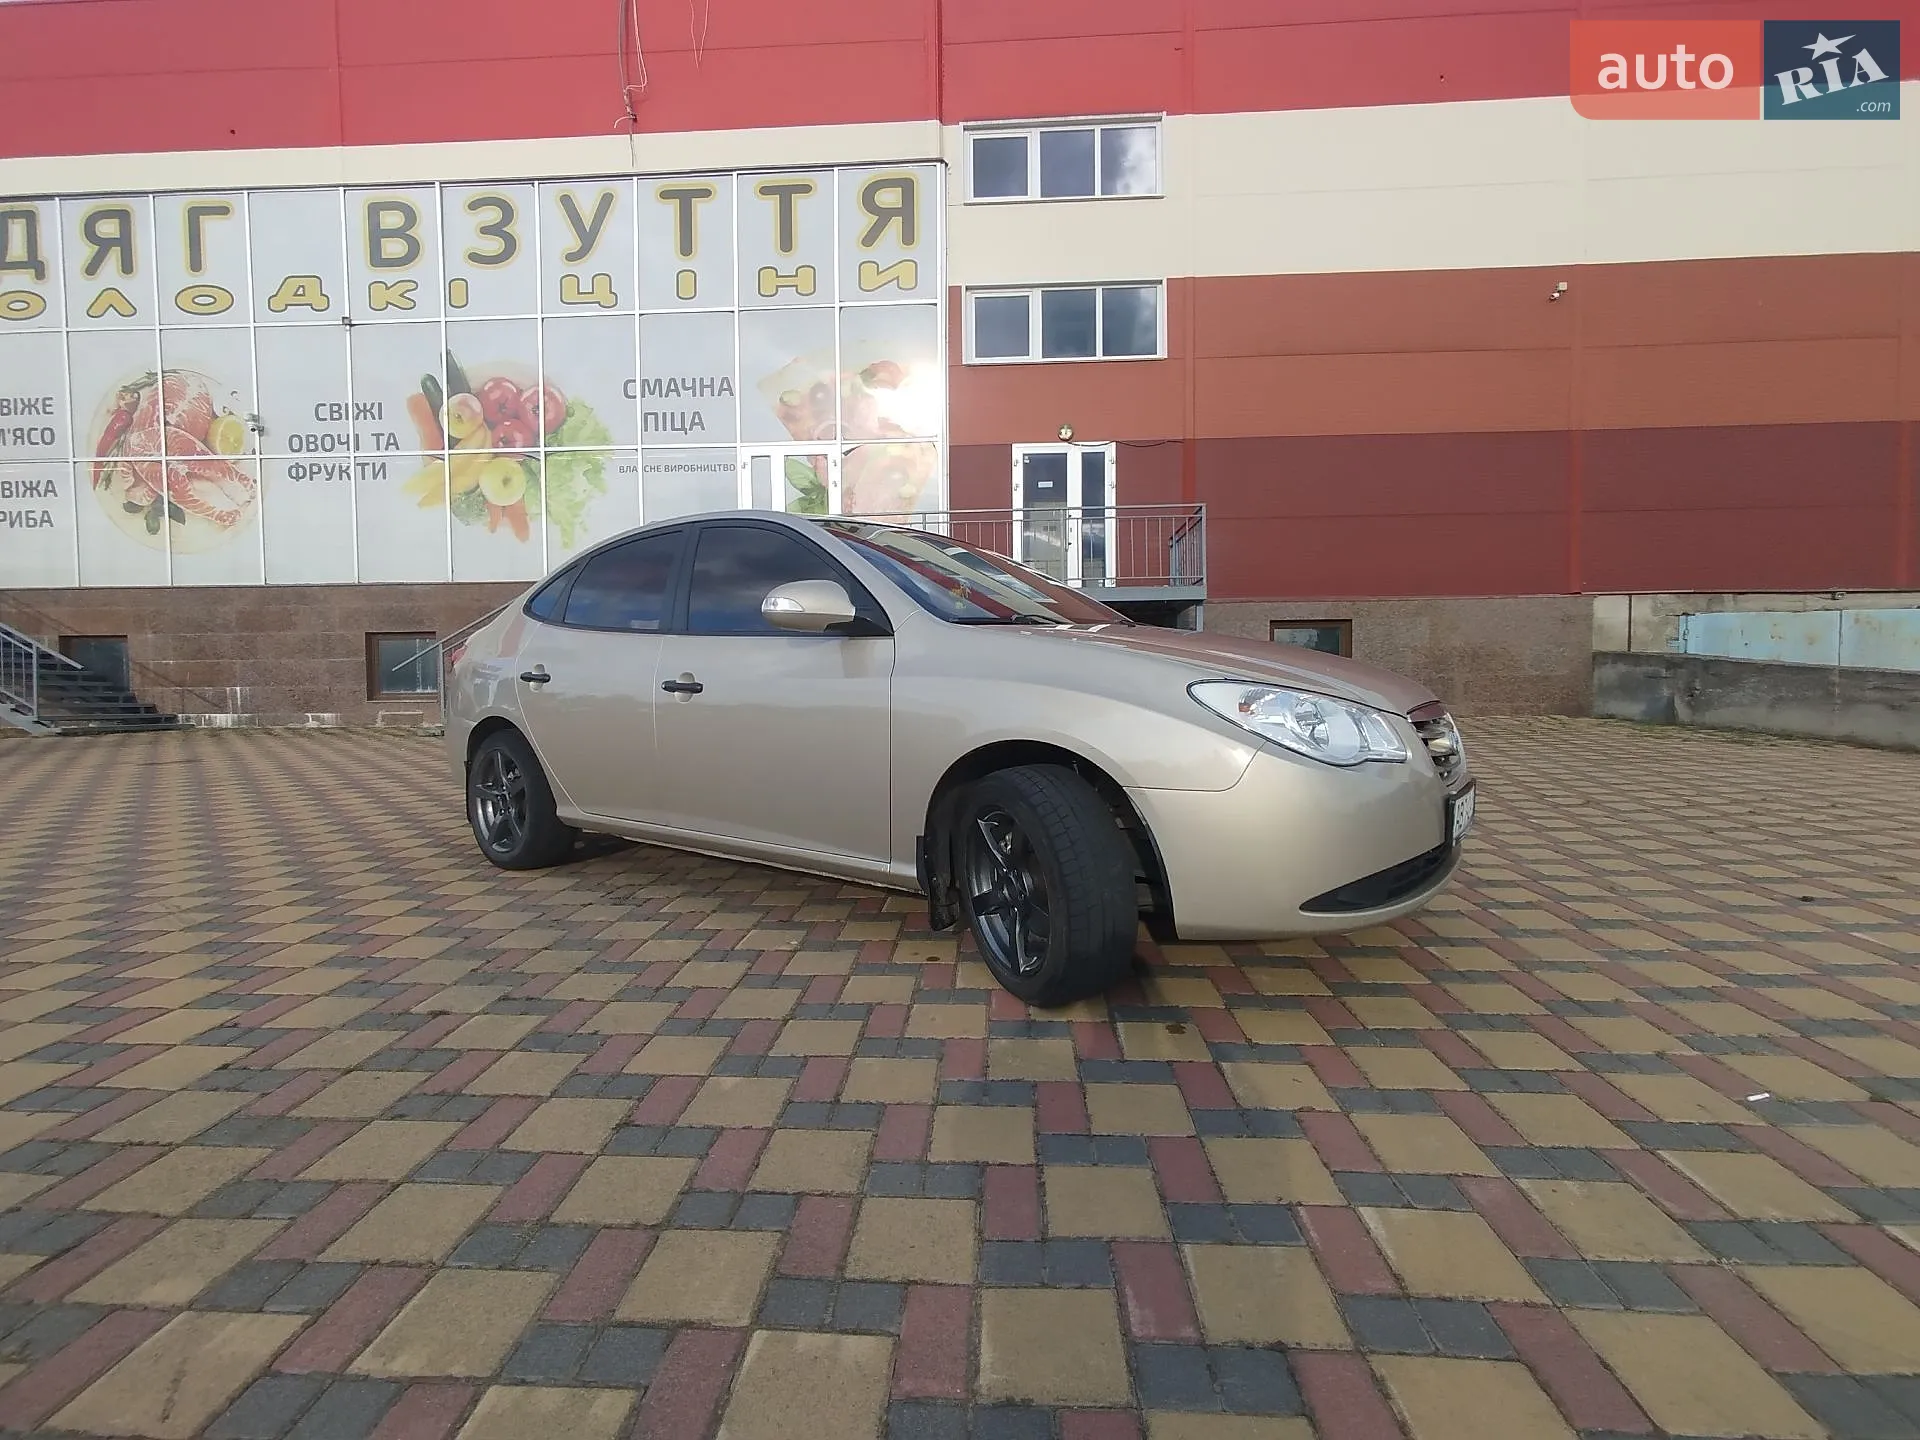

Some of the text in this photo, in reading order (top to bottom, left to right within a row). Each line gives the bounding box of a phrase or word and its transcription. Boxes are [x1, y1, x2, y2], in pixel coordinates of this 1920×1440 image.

[363, 174, 920, 271] ВЗУТТЯ
[559, 259, 918, 309] ЦІНИ
[622, 376, 734, 401] СМАЧНА
[314, 402, 383, 421] СВІЖІ
[642, 411, 705, 435] ПІЦА
[288, 432, 400, 453] ОВОЧІ ТА
[287, 462, 387, 481] ФРУКТИ
[619, 463, 736, 474] ВЛАСНЕ ВИРОБНИЦТВО
